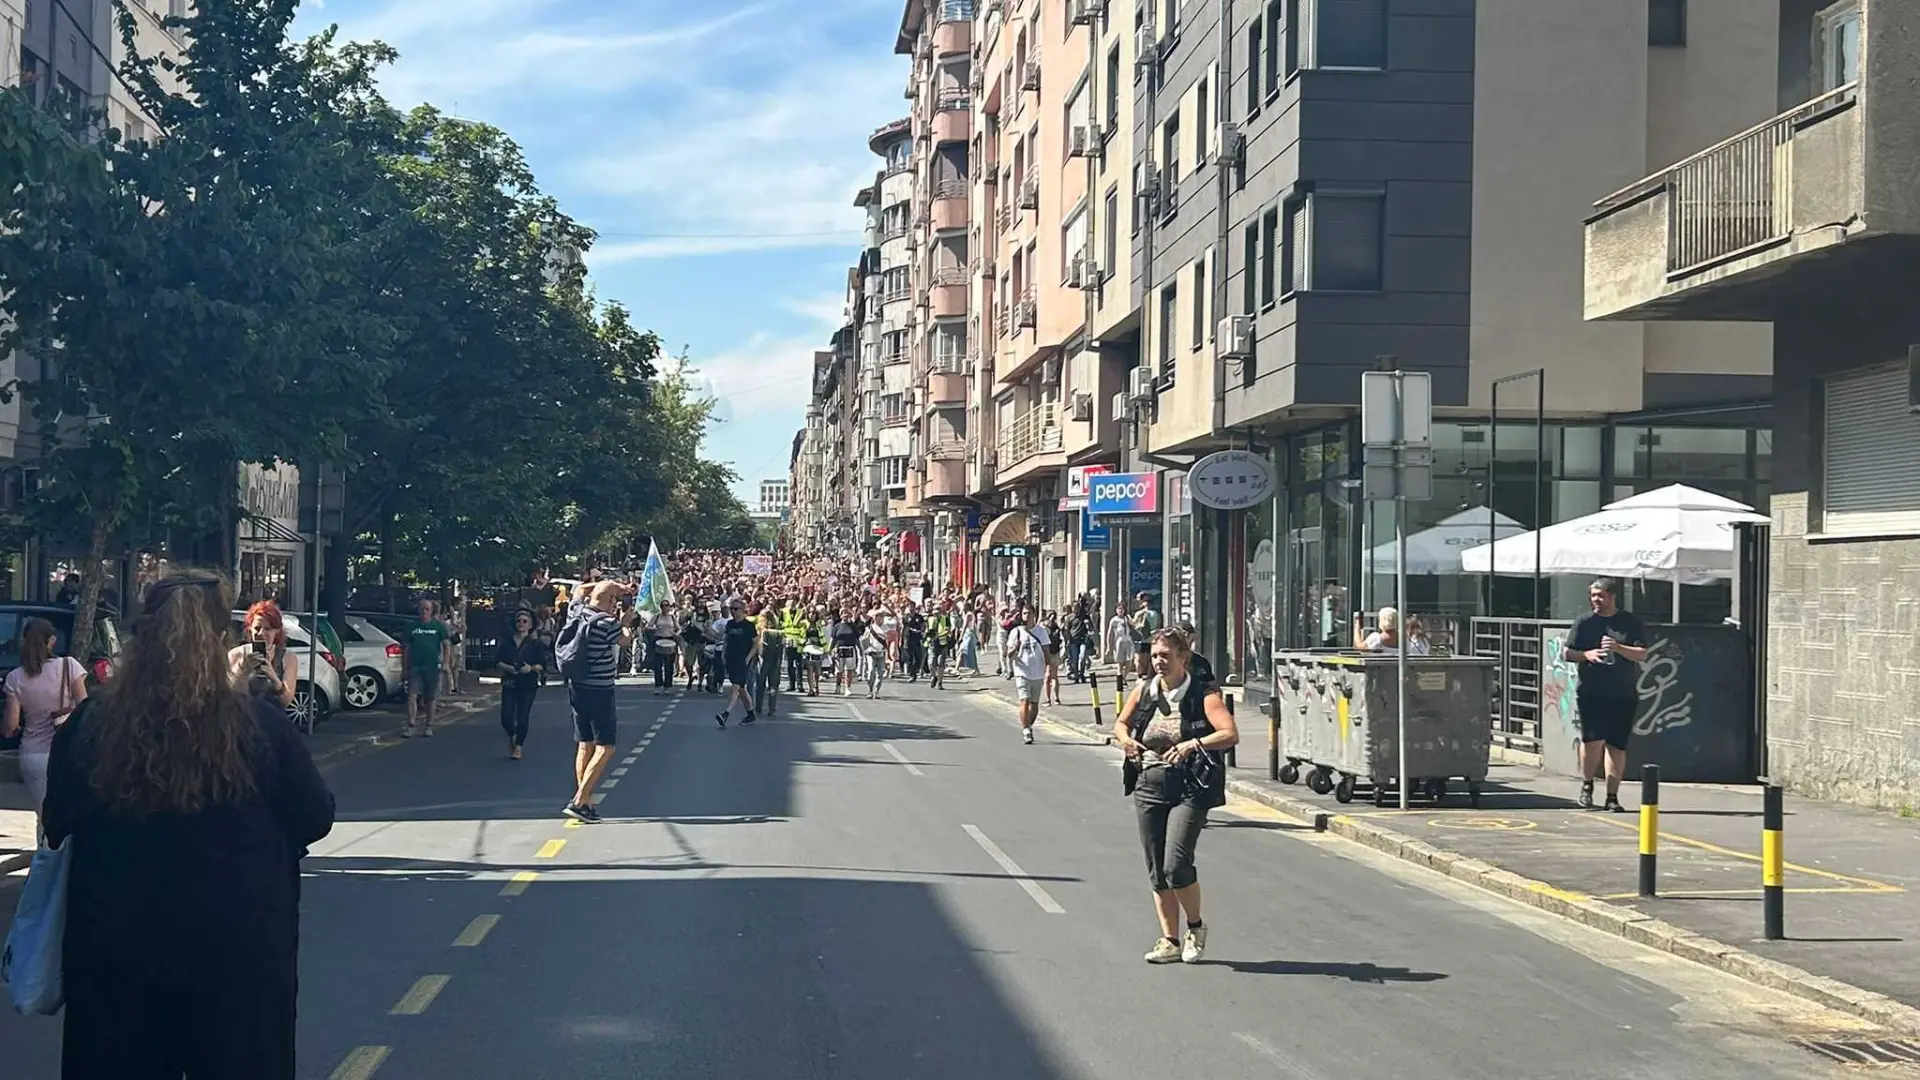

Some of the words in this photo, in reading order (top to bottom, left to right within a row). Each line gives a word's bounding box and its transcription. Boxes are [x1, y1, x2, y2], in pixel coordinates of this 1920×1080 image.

[1095, 482, 1146, 503] pepco
[993, 544, 1025, 555] ria
[1132, 571, 1162, 581] pepc
